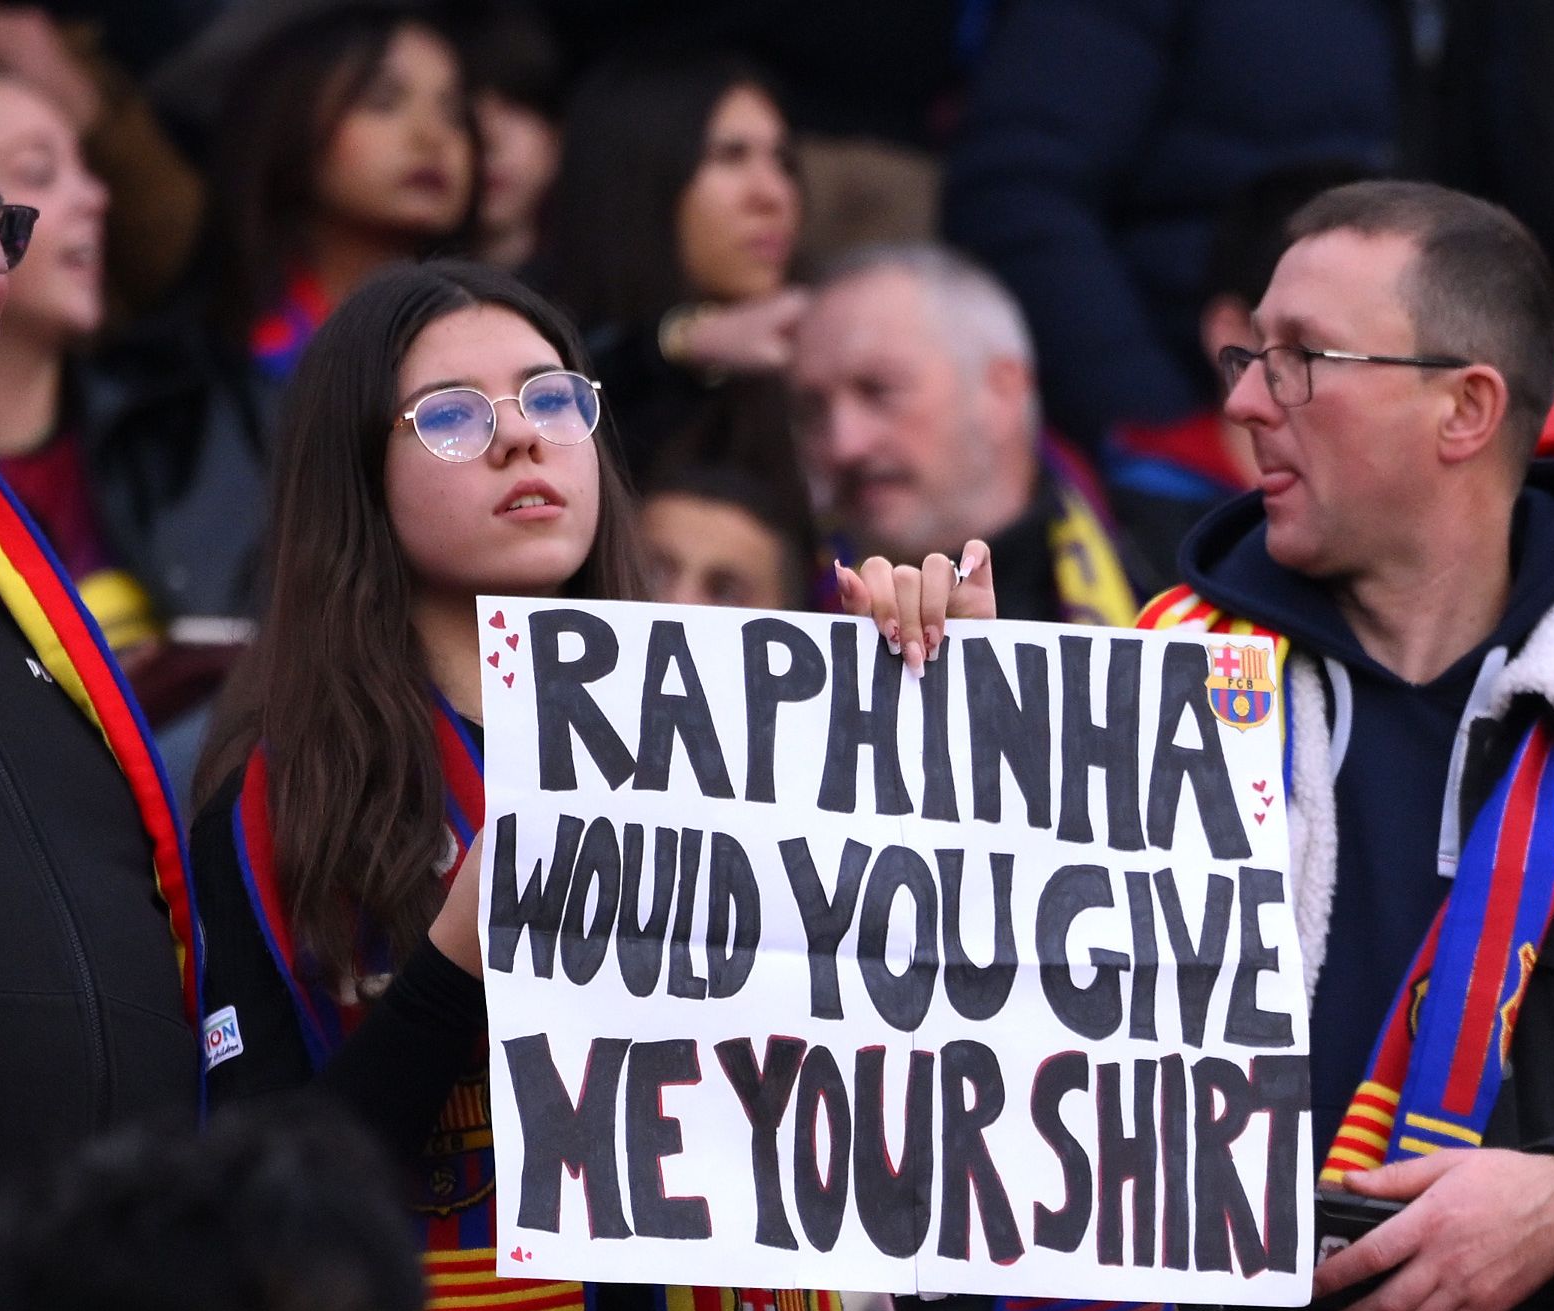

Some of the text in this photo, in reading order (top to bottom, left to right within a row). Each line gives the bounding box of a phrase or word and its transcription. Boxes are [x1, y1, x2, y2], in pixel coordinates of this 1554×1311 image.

[528, 608, 1252, 860] RAPHINHA
[1227, 678, 1254, 690] FCB
[488, 812, 1311, 1049] WOULD YOU GIVE
[501, 1032, 1311, 1279] ME YOUR SHIRT
